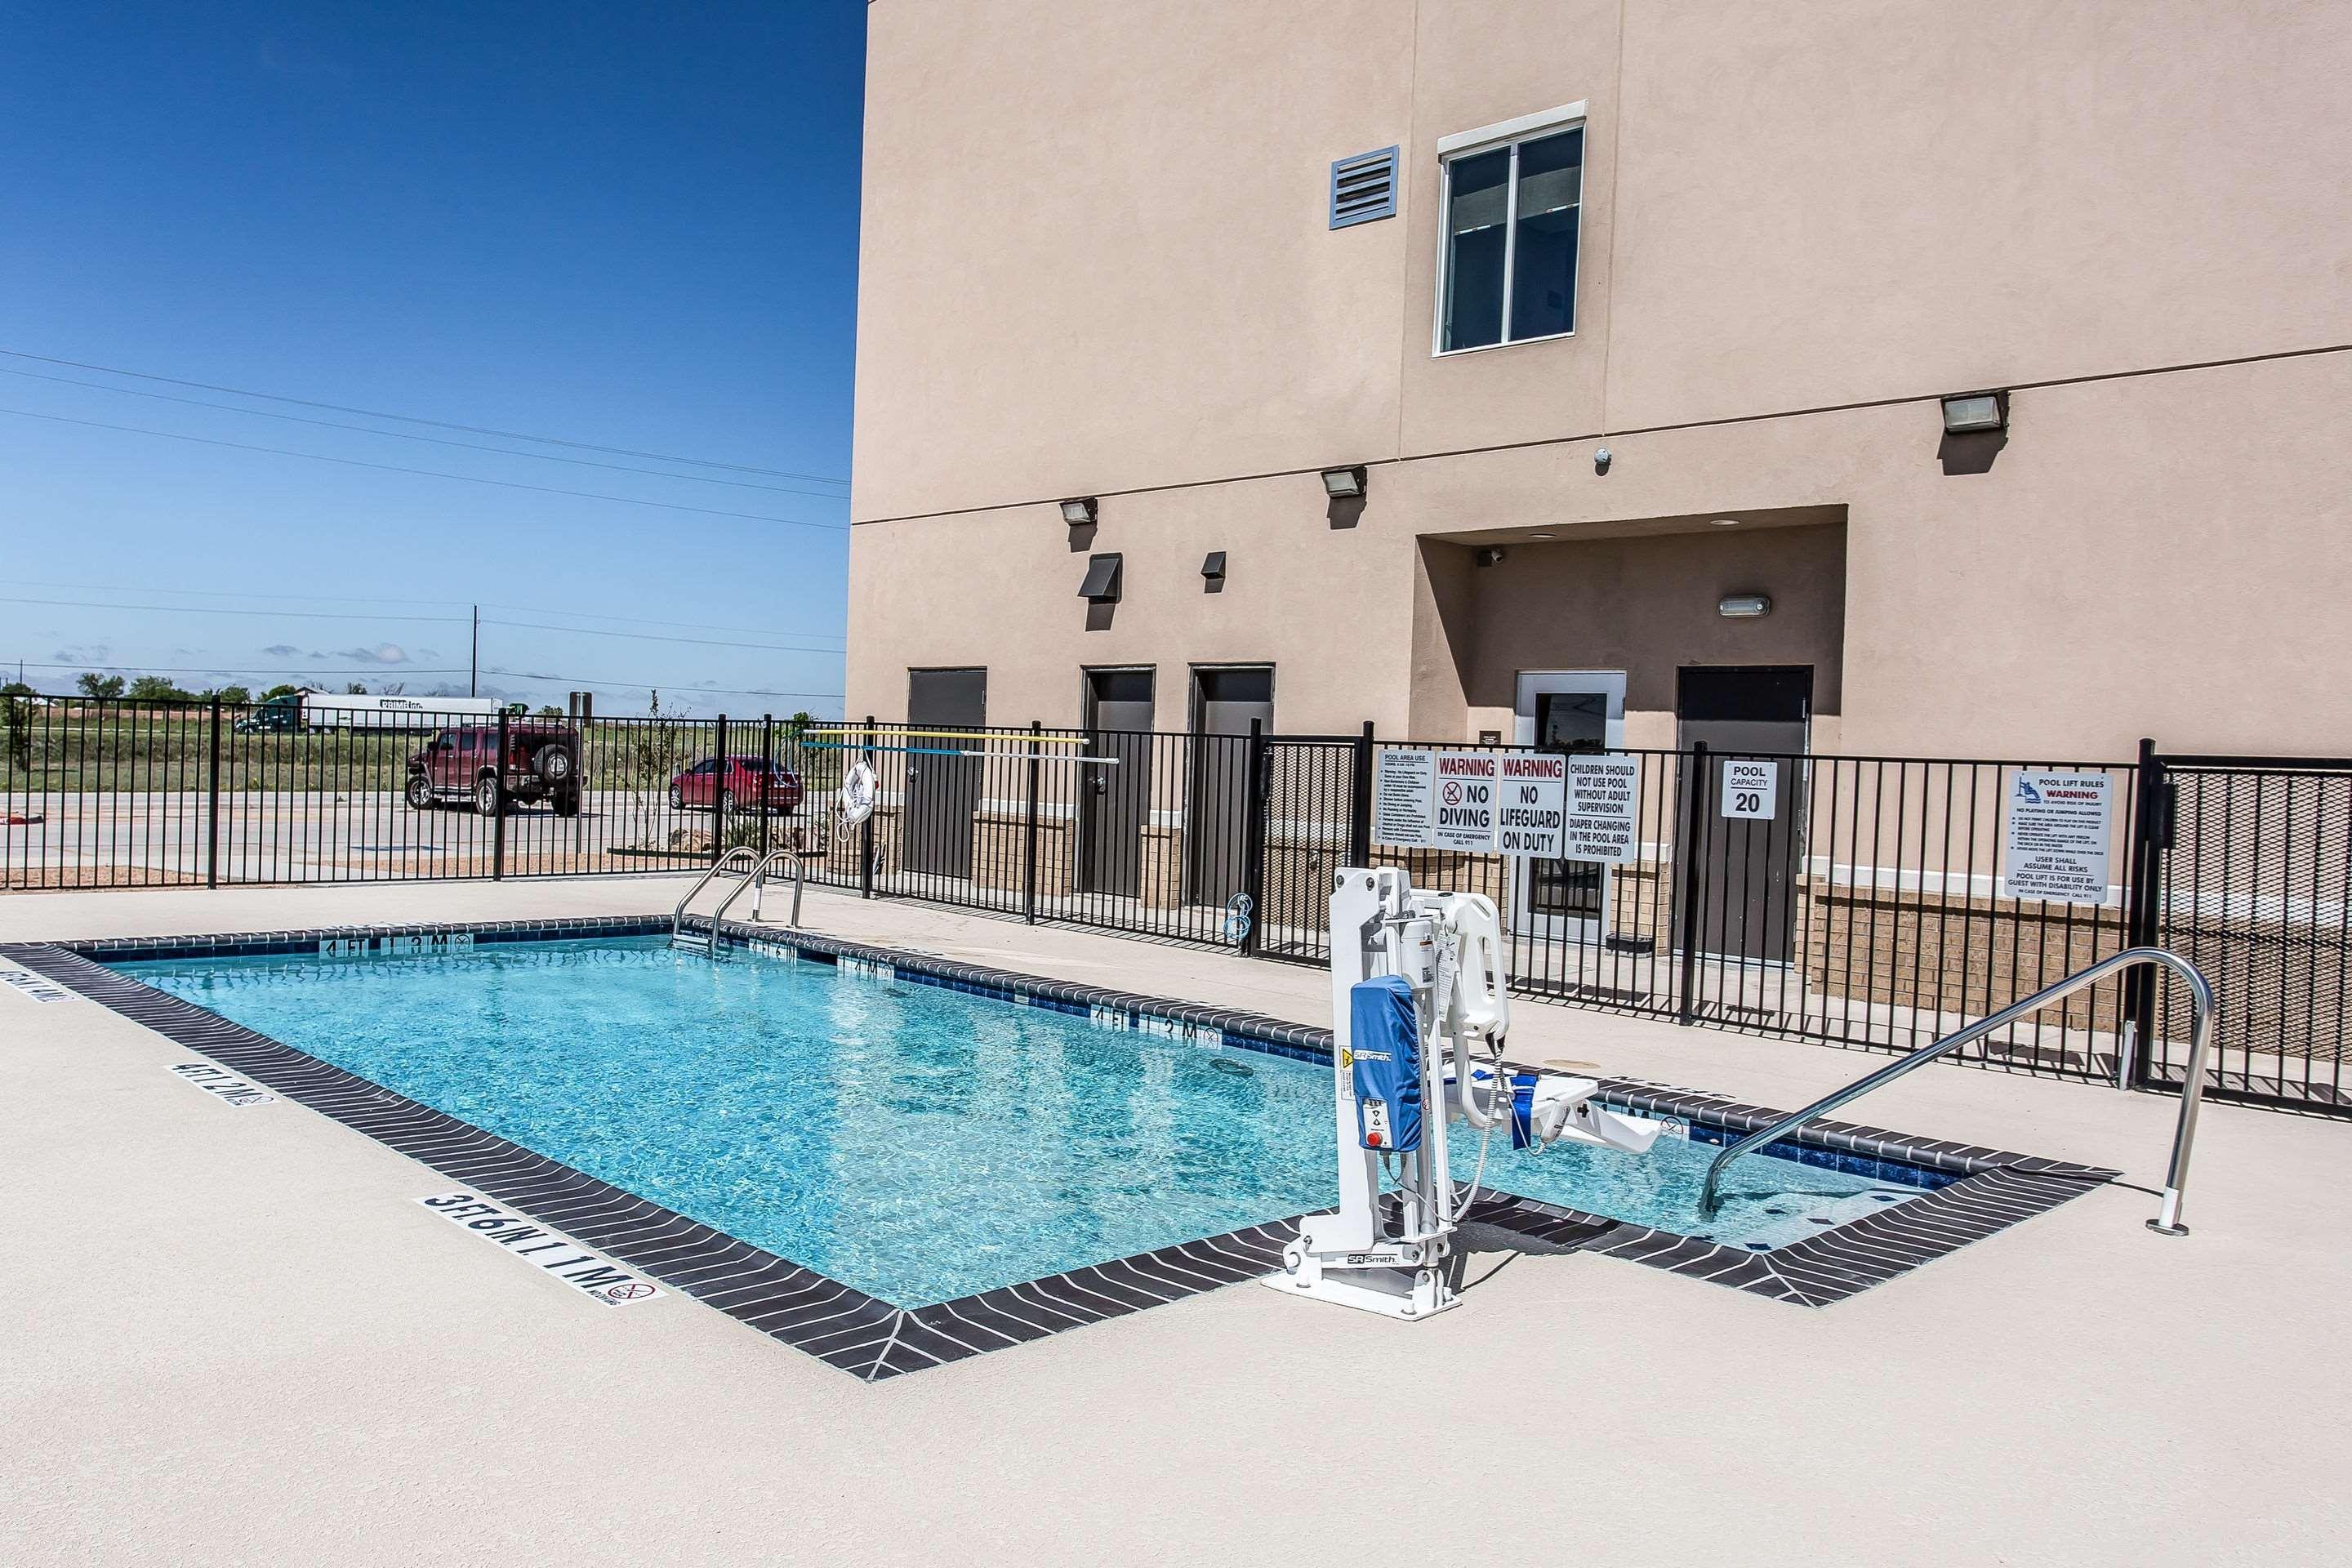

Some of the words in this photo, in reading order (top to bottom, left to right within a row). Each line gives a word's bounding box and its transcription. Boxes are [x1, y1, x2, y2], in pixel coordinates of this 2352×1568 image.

[1439, 758, 1494, 776] WARNING
[1503, 759, 1562, 778] WARNING
[1570, 764, 1604, 775] CHILDREN
[1605, 765, 1634, 776] SHOULD
[1733, 766, 1766, 777] POOL
[1576, 777, 1592, 786] NOT
[1593, 777, 1606, 787] USE
[1607, 778, 1627, 788] POOL
[1467, 785, 1489, 804] NO
[1520, 786, 1538, 804] NO
[1575, 789, 1606, 800] WITHOUT
[1607, 791, 1631, 801] ADULT
[2047, 790, 2098, 799] WARNING
[1578, 802, 1624, 813] SUPERVISION
[1735, 793, 1760, 813] 20
[1440, 808, 1490, 827] DIVING
[1500, 808, 1560, 829] LIFEGUARD
[1570, 819, 1592, 829] DIAPER
[1593, 820, 1630, 831] CHANGING
[1503, 831, 1520, 850] ON
[1524, 833, 1554, 852] DUTY
[1570, 831, 1577, 840] IN
[1579, 831, 1591, 842] THE
[1592, 833, 1610, 843] POOL
[1612, 835, 1629, 844] AREA
[1575, 844, 1581, 853] IS
[1583, 844, 1622, 857] PROHIBITED
[2024, 862, 2052, 871] ASSUME
[2055, 857, 2077, 865] SHALL
[2049, 882, 2082, 890] DISABILITY
[431, 934, 448, 946] M
[867, 959, 877, 973] M
[1113, 1009, 1126, 1024] FT
[1182, 1022, 1196, 1038] M
[215, 1088, 264, 1098] M
[424, 1195, 474, 1206] 3
[468, 1218, 522, 1229] 6
[562, 1266, 634, 1288] M
